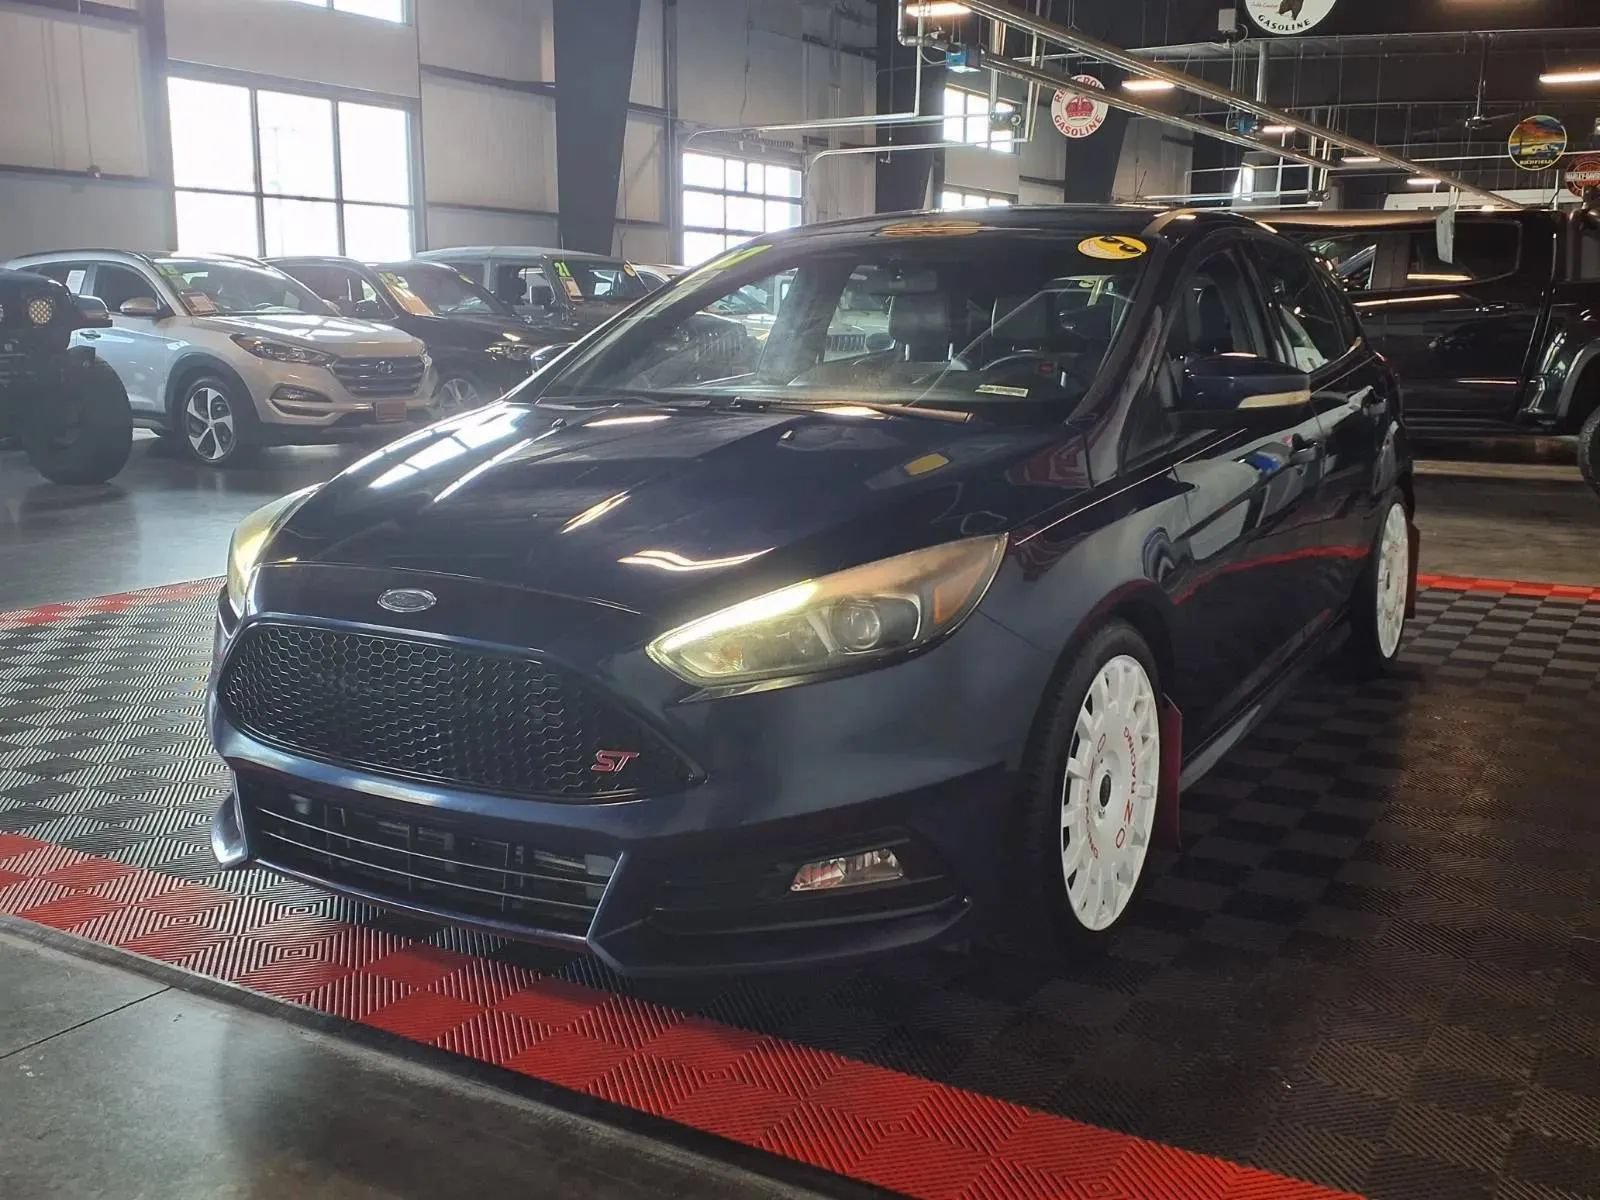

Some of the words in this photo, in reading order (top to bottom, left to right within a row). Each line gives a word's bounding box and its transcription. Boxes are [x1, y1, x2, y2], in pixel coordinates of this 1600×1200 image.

[1258, 14, 1311, 31] GASOLINE
[1054, 114, 1103, 136] GASOLINE
[591, 750, 640, 771] ST
[1123, 725, 1137, 794] RACING
